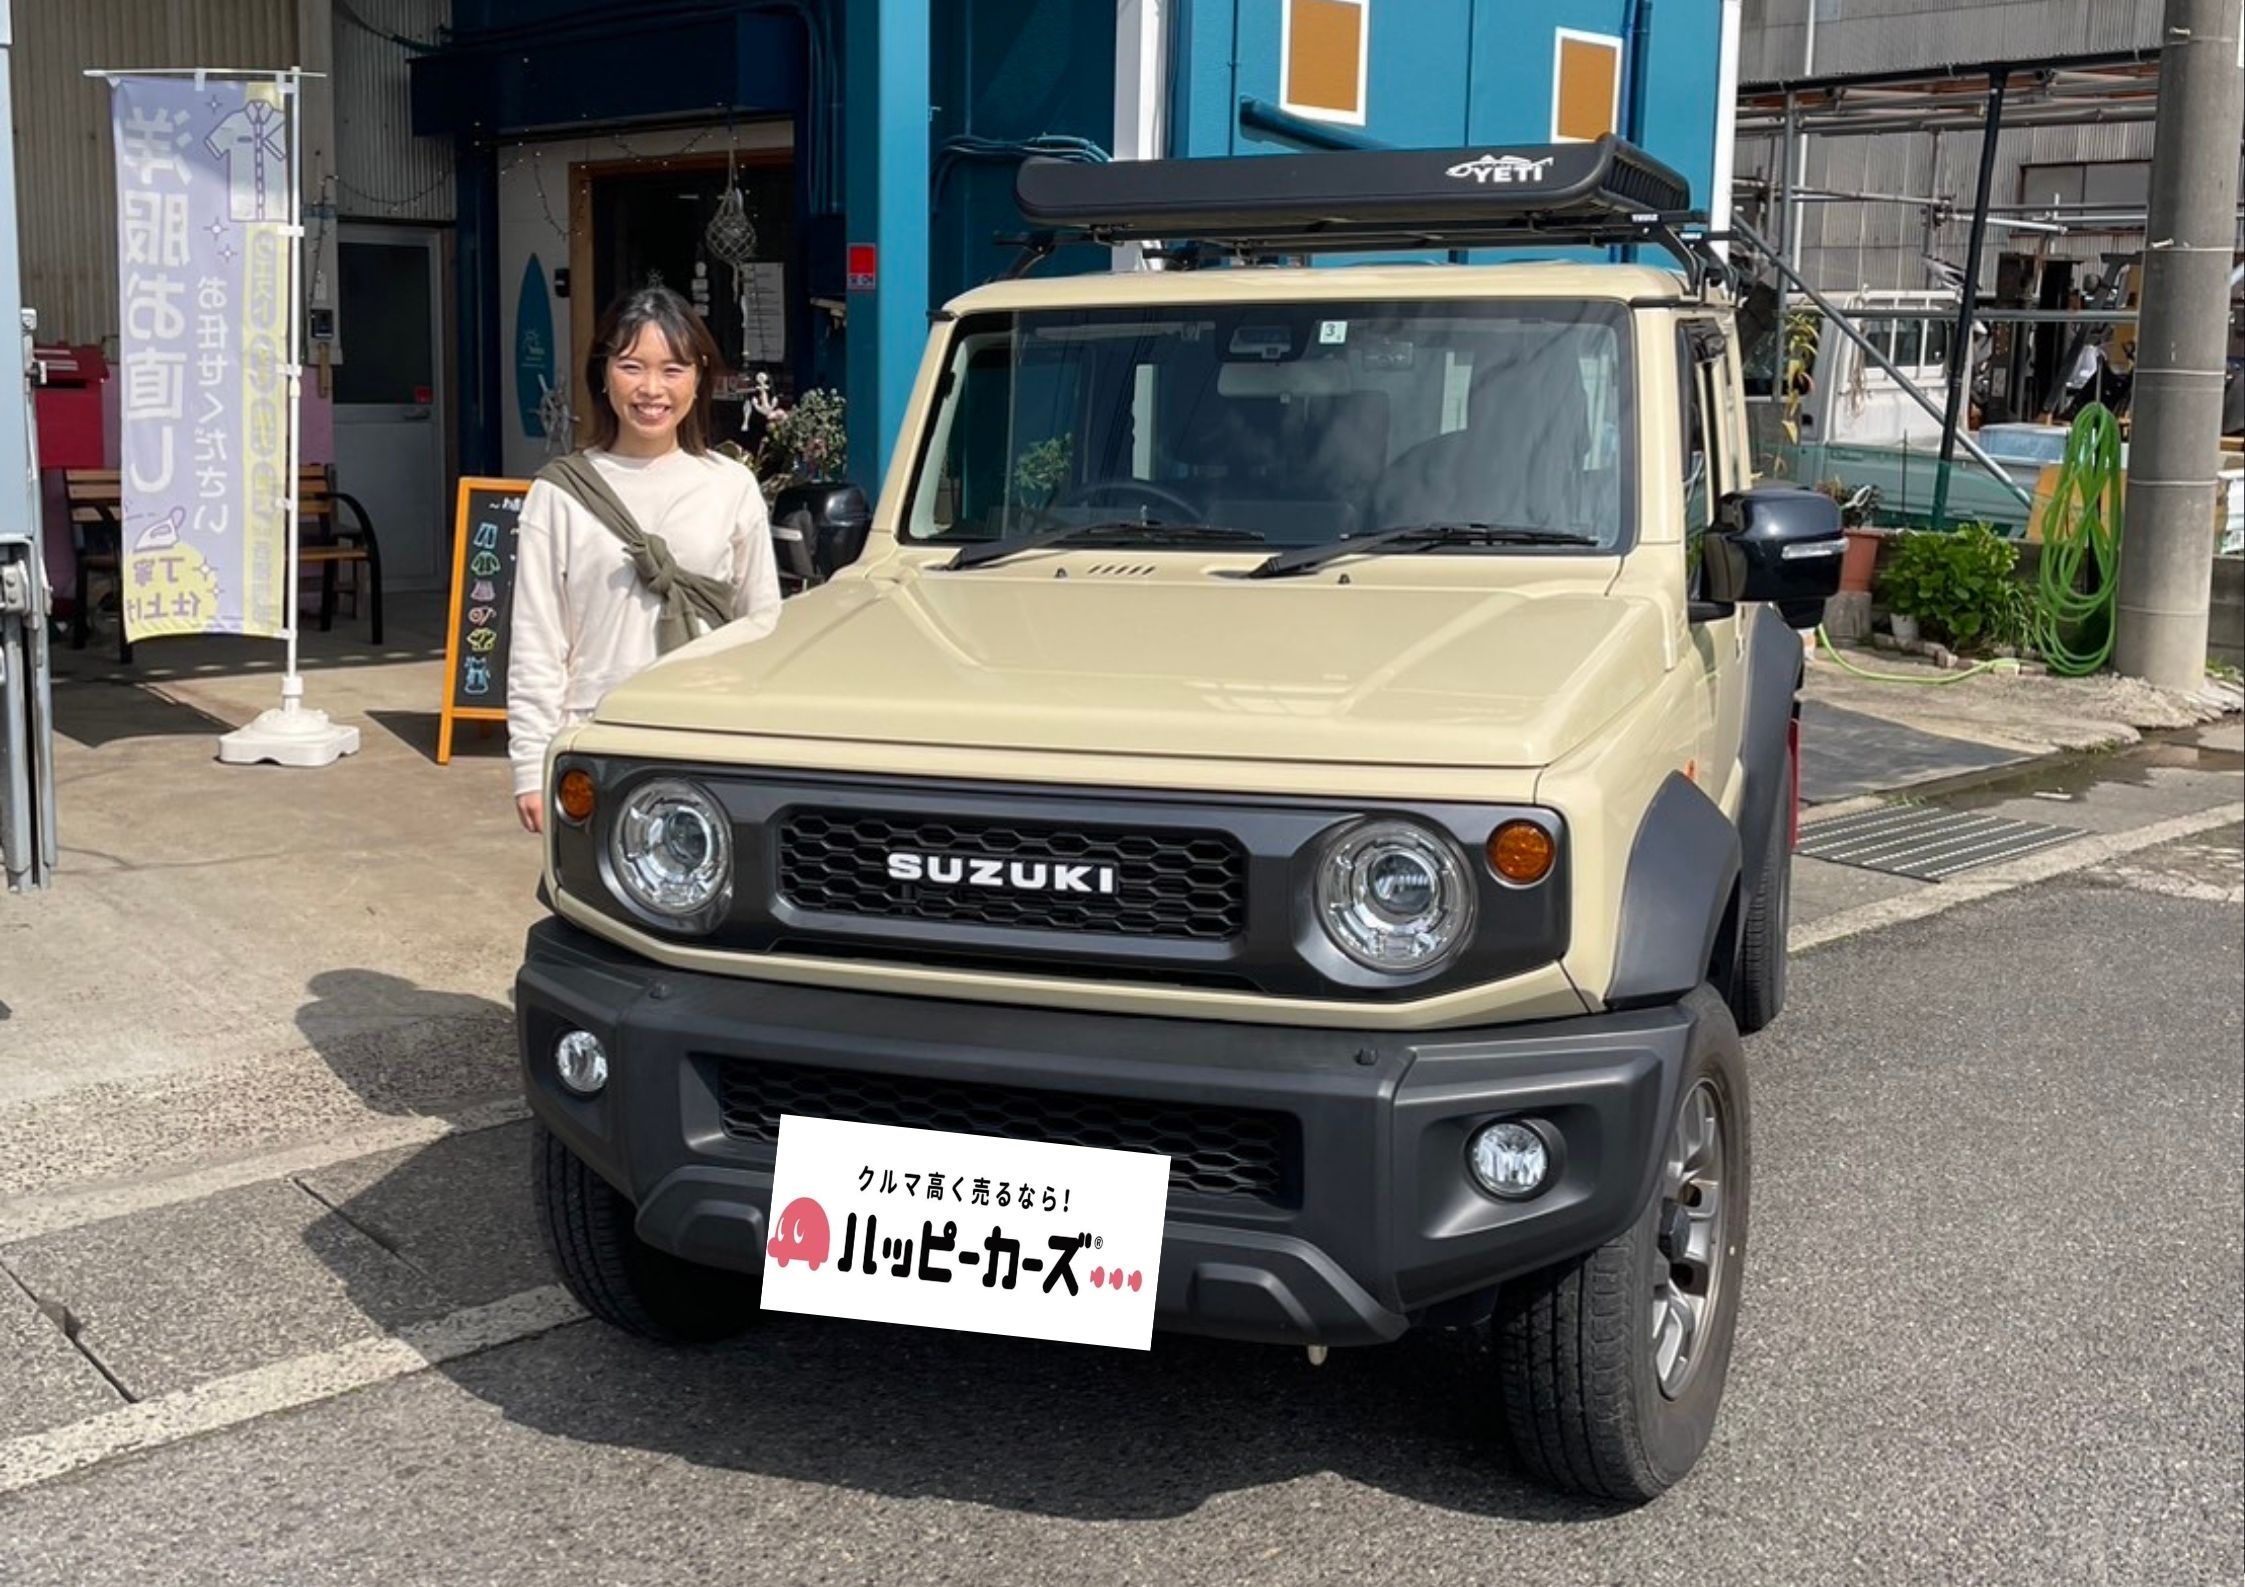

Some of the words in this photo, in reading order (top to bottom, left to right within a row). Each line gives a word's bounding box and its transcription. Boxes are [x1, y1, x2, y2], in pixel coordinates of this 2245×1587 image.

[1473, 165, 1543, 183] YETI
[1325, 323, 1336, 337] 3
[887, 852, 1114, 894] SUZUKI
